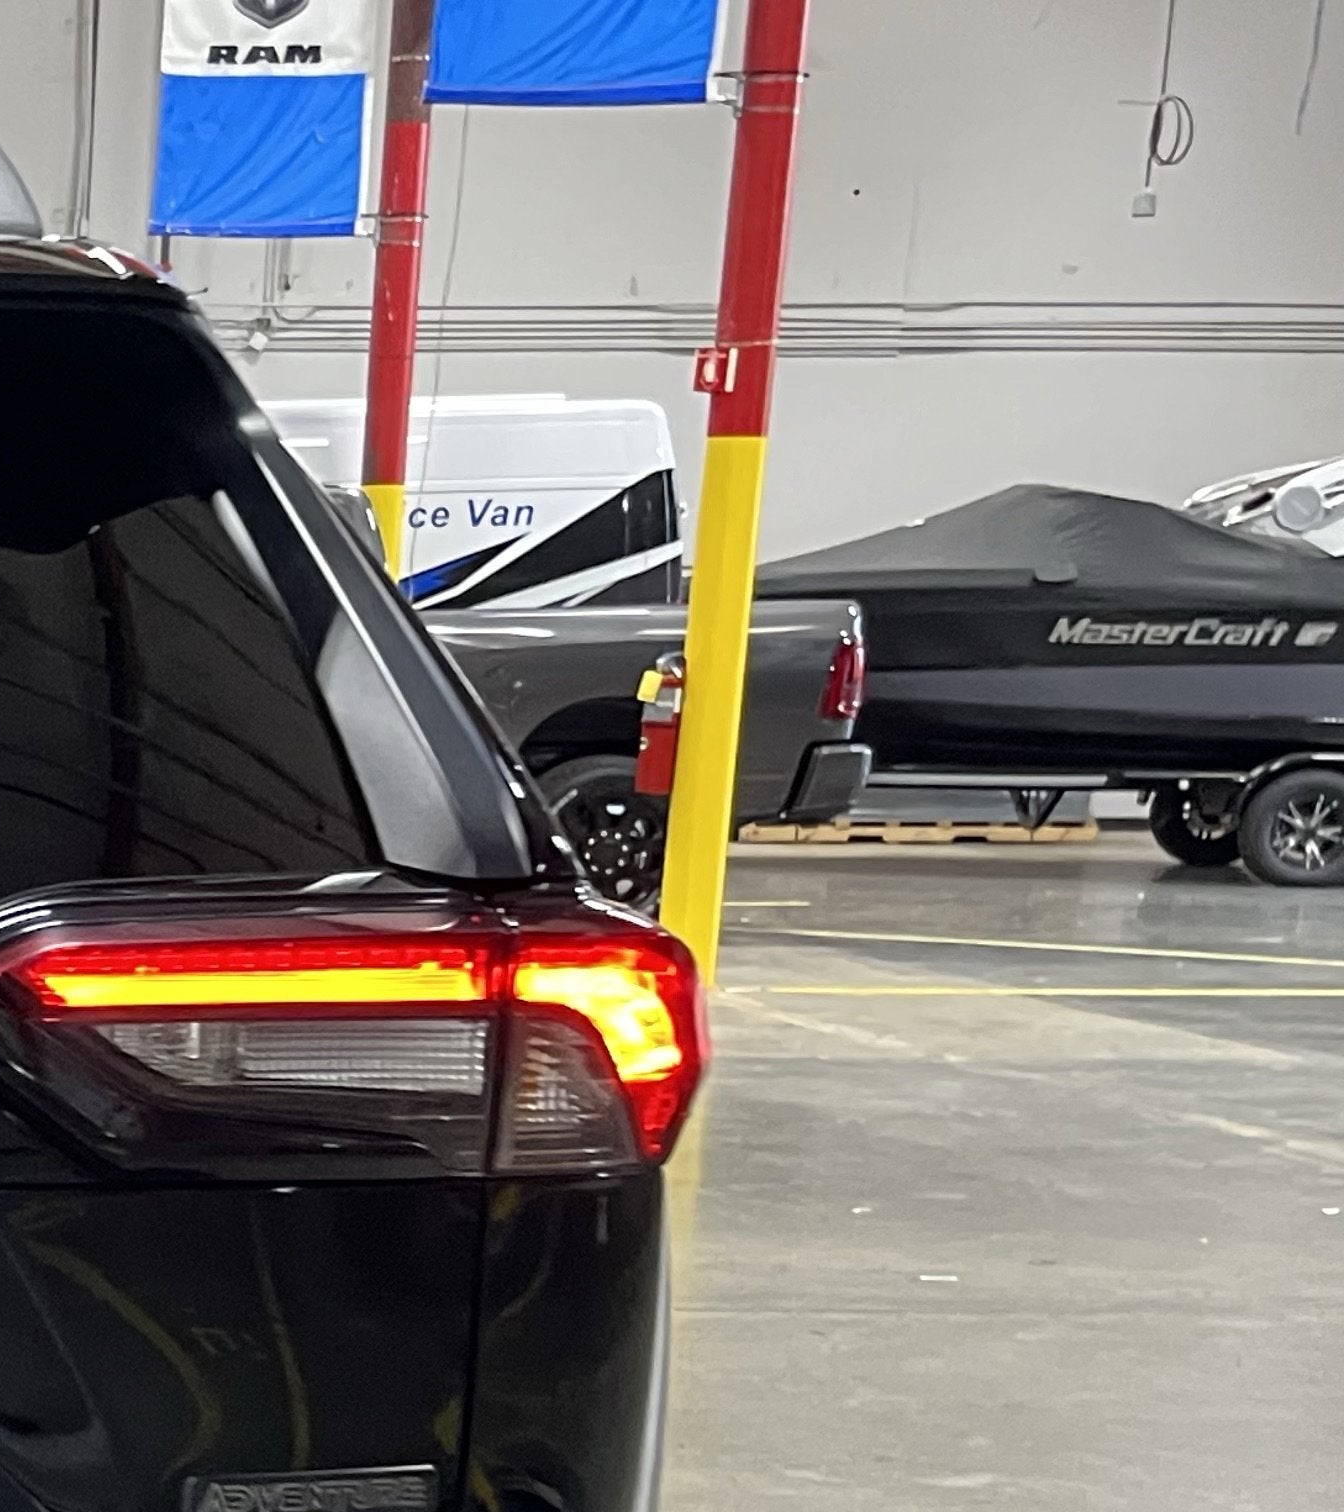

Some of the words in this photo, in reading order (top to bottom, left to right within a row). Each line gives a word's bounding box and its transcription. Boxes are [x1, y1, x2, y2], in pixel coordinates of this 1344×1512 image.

[207, 45, 321, 65] RAM
[467, 498, 535, 528] Van
[1048, 616, 1289, 647] MasterCraft
